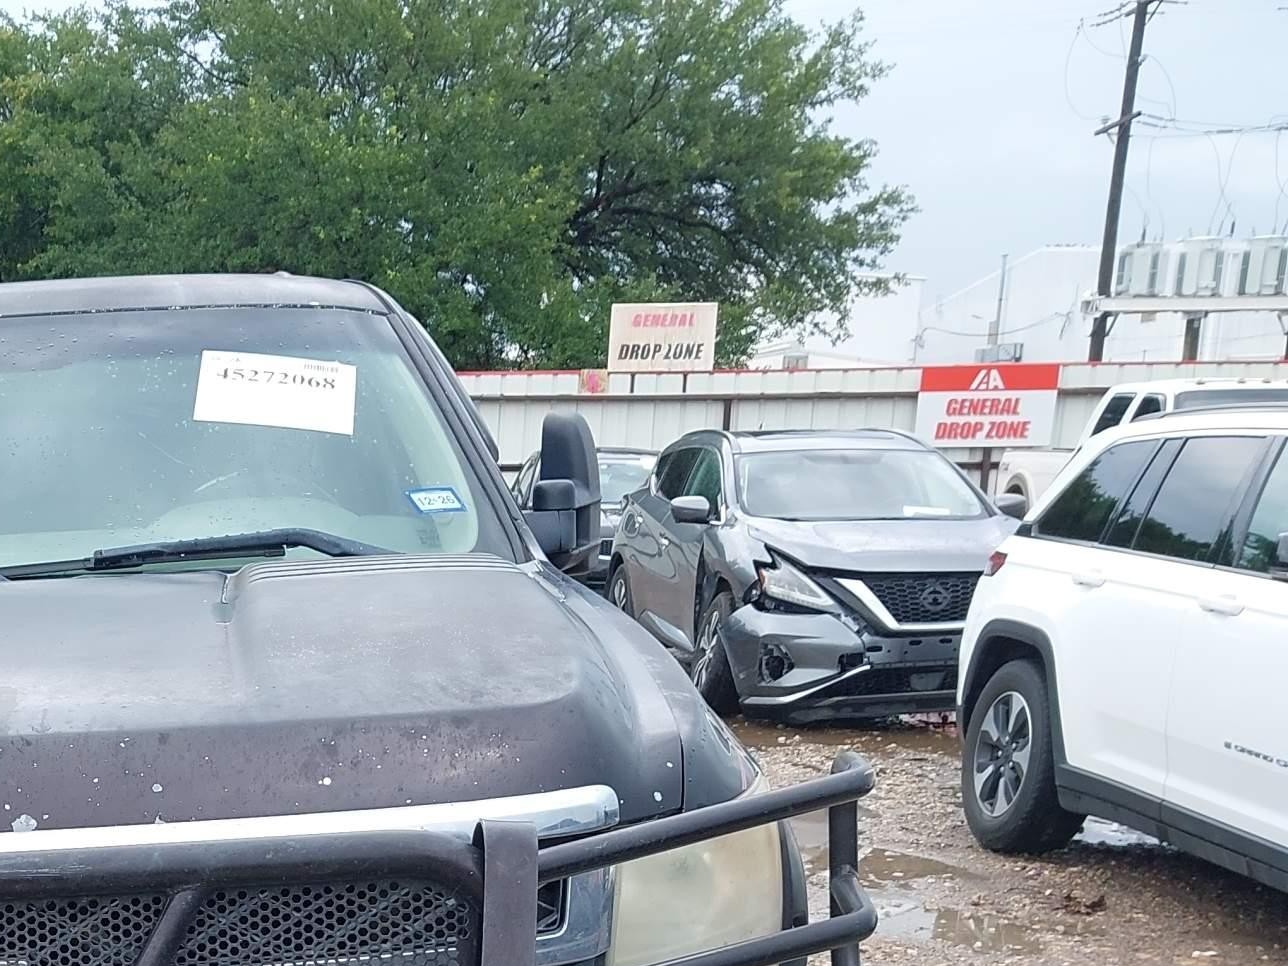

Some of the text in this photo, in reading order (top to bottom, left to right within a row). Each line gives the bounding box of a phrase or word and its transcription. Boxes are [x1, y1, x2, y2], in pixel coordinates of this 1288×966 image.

[632, 313, 696, 328] GENERAL
[617, 342, 704, 360] DROP ZONE
[216, 367, 336, 389] 45272068
[945, 397, 1021, 416] GENERAL
[934, 420, 1031, 440] DROP ZONE
